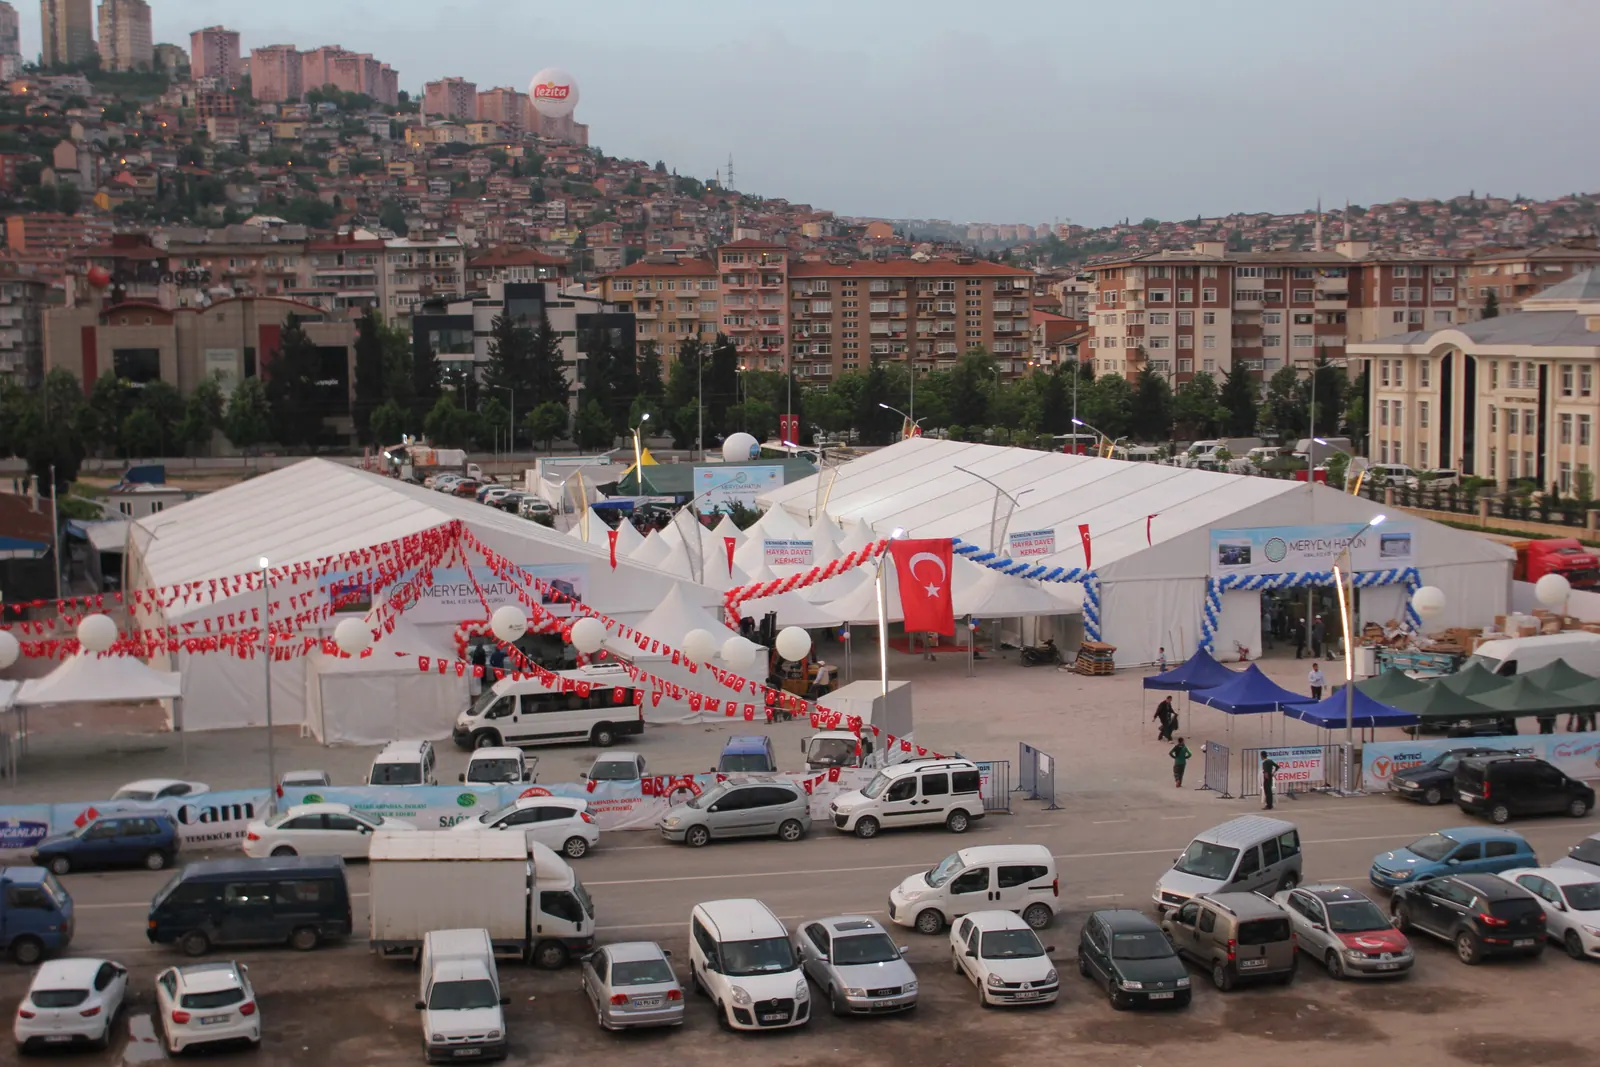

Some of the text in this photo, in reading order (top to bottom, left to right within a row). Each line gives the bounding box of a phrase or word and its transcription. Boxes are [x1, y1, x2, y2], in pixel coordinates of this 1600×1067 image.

[536, 87, 566, 97] lezita
[1012, 540, 1033, 548] HAYRA
[1289, 539, 1331, 551] MERYEM
[1020, 546, 1048, 555] KERMESİ
[423, 584, 477, 597] MERYEM
[1393, 752, 1422, 760] KÖFTECİ
[1292, 760, 1320, 768] DAVET
[1273, 770, 1310, 781] KERMESİ
[178, 802, 255, 825] Cam
